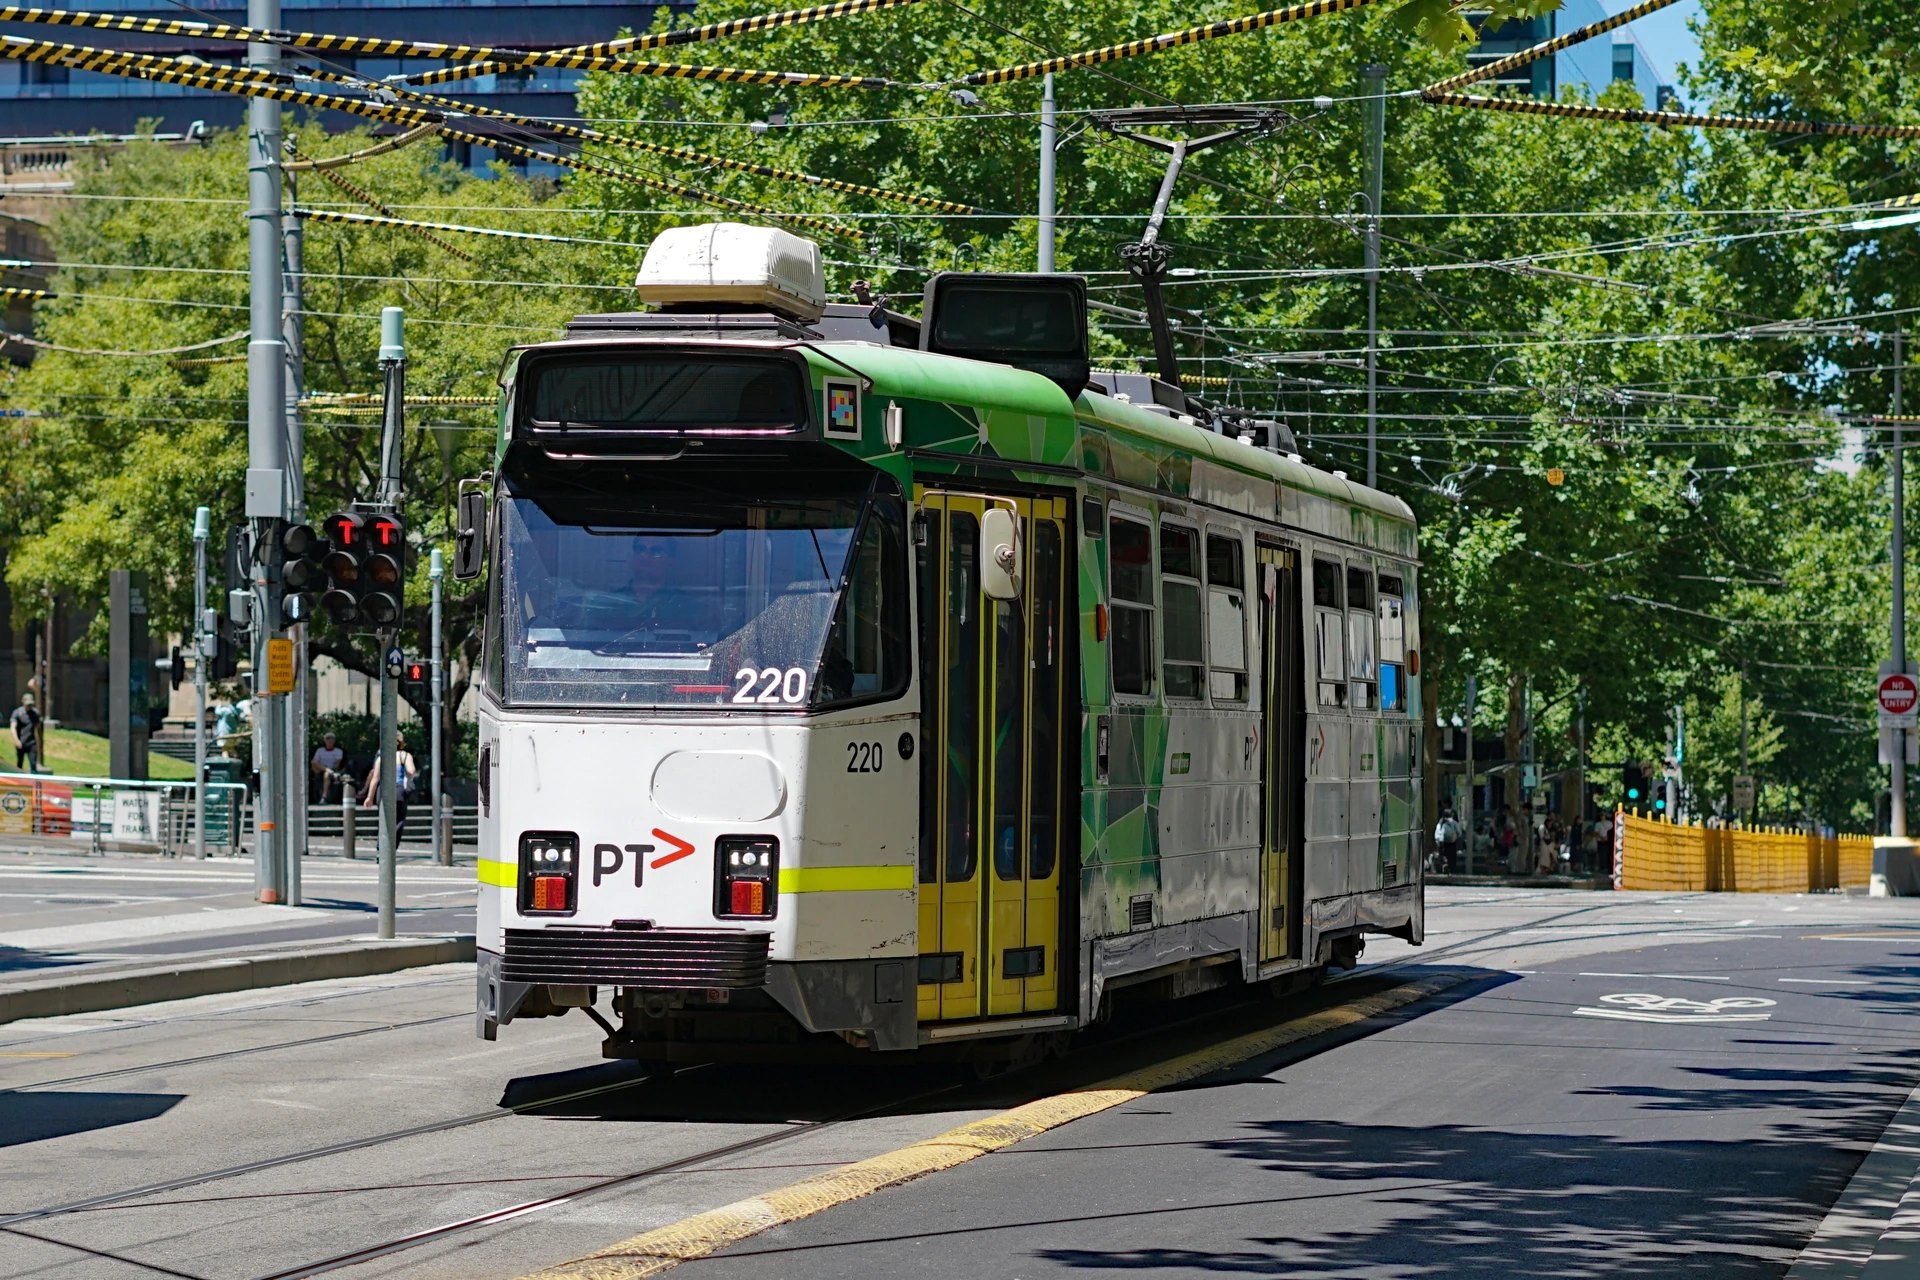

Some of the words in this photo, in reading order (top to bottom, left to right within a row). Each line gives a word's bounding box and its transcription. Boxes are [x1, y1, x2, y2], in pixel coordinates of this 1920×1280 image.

[338, 521, 355, 545] T
[376, 523, 396, 545] T
[731, 667, 808, 704] 220
[1891, 681, 1905, 690] NO
[1884, 699, 1912, 708] ENTRY
[847, 742, 883, 773] 220
[122, 799, 149, 808] WATCH
[127, 812, 145, 821] FOR
[121, 825, 151, 834] TRAMS
